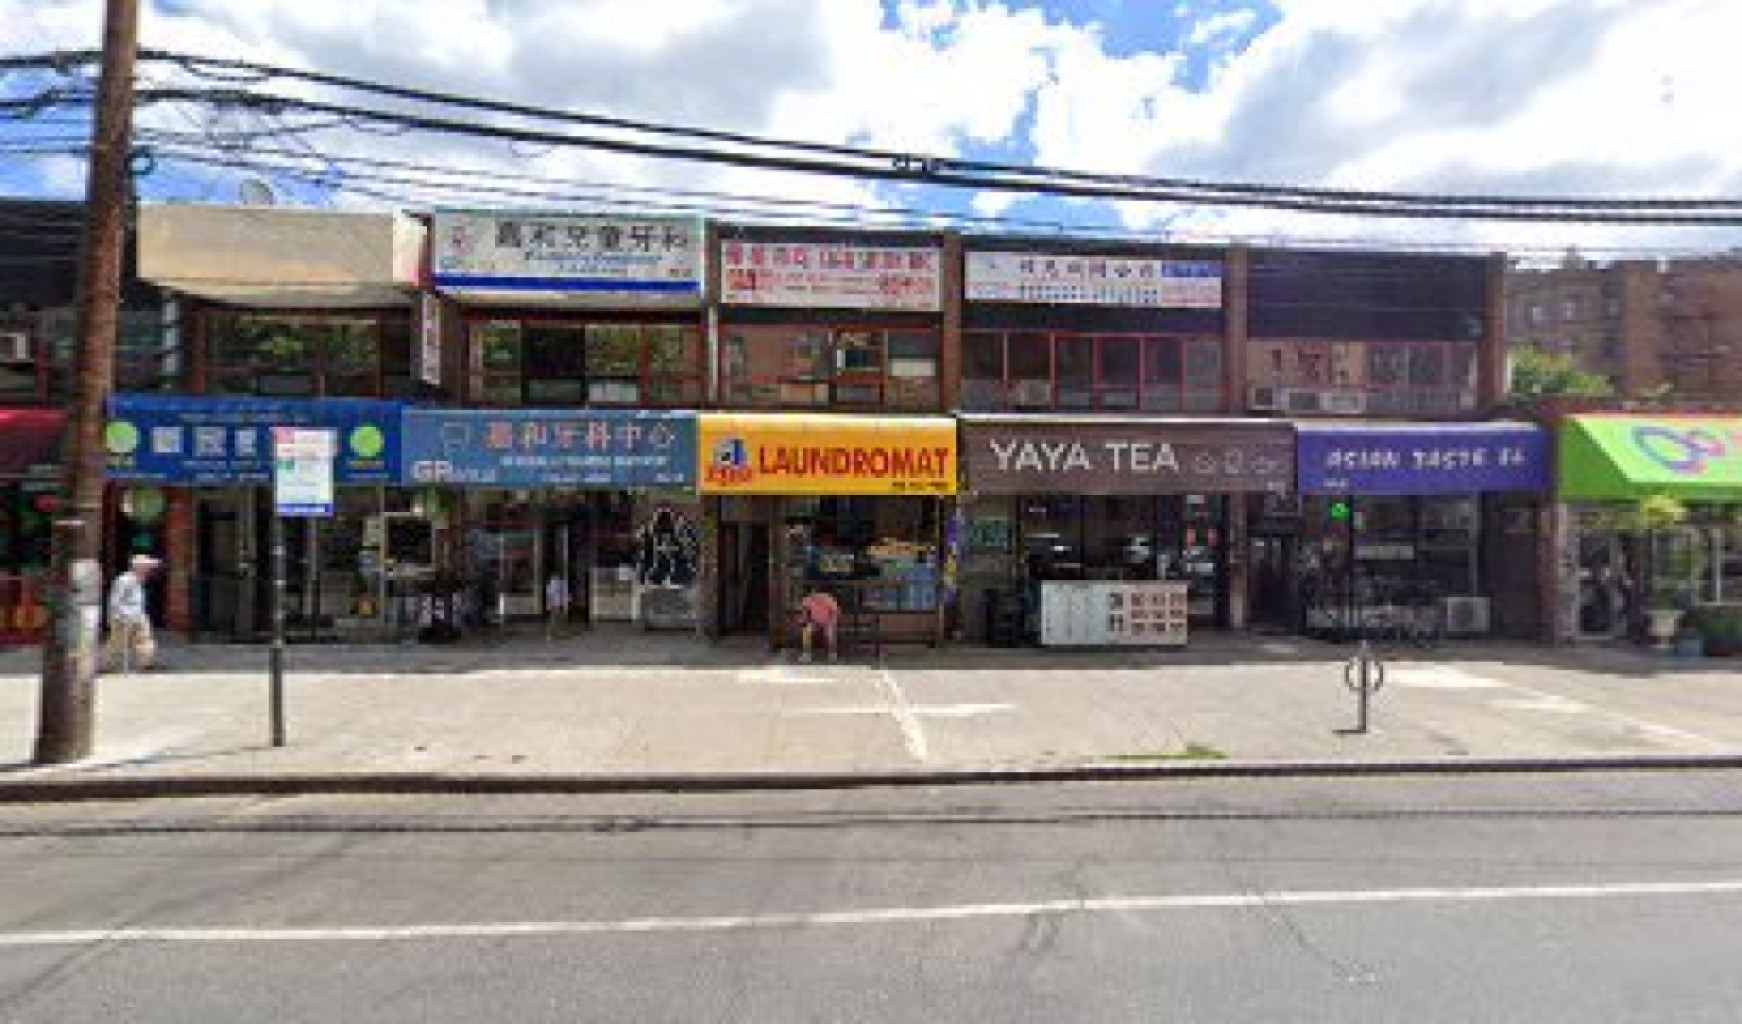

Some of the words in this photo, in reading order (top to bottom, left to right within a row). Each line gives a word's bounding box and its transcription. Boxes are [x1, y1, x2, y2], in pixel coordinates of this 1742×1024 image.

[758, 445, 950, 479] LAUNDROMAT
[989, 438, 1091, 472] YAYA
[1104, 441, 1180, 474] TEA
[1325, 448, 1401, 469] ASIAN
[1412, 447, 1488, 469] TASTE
